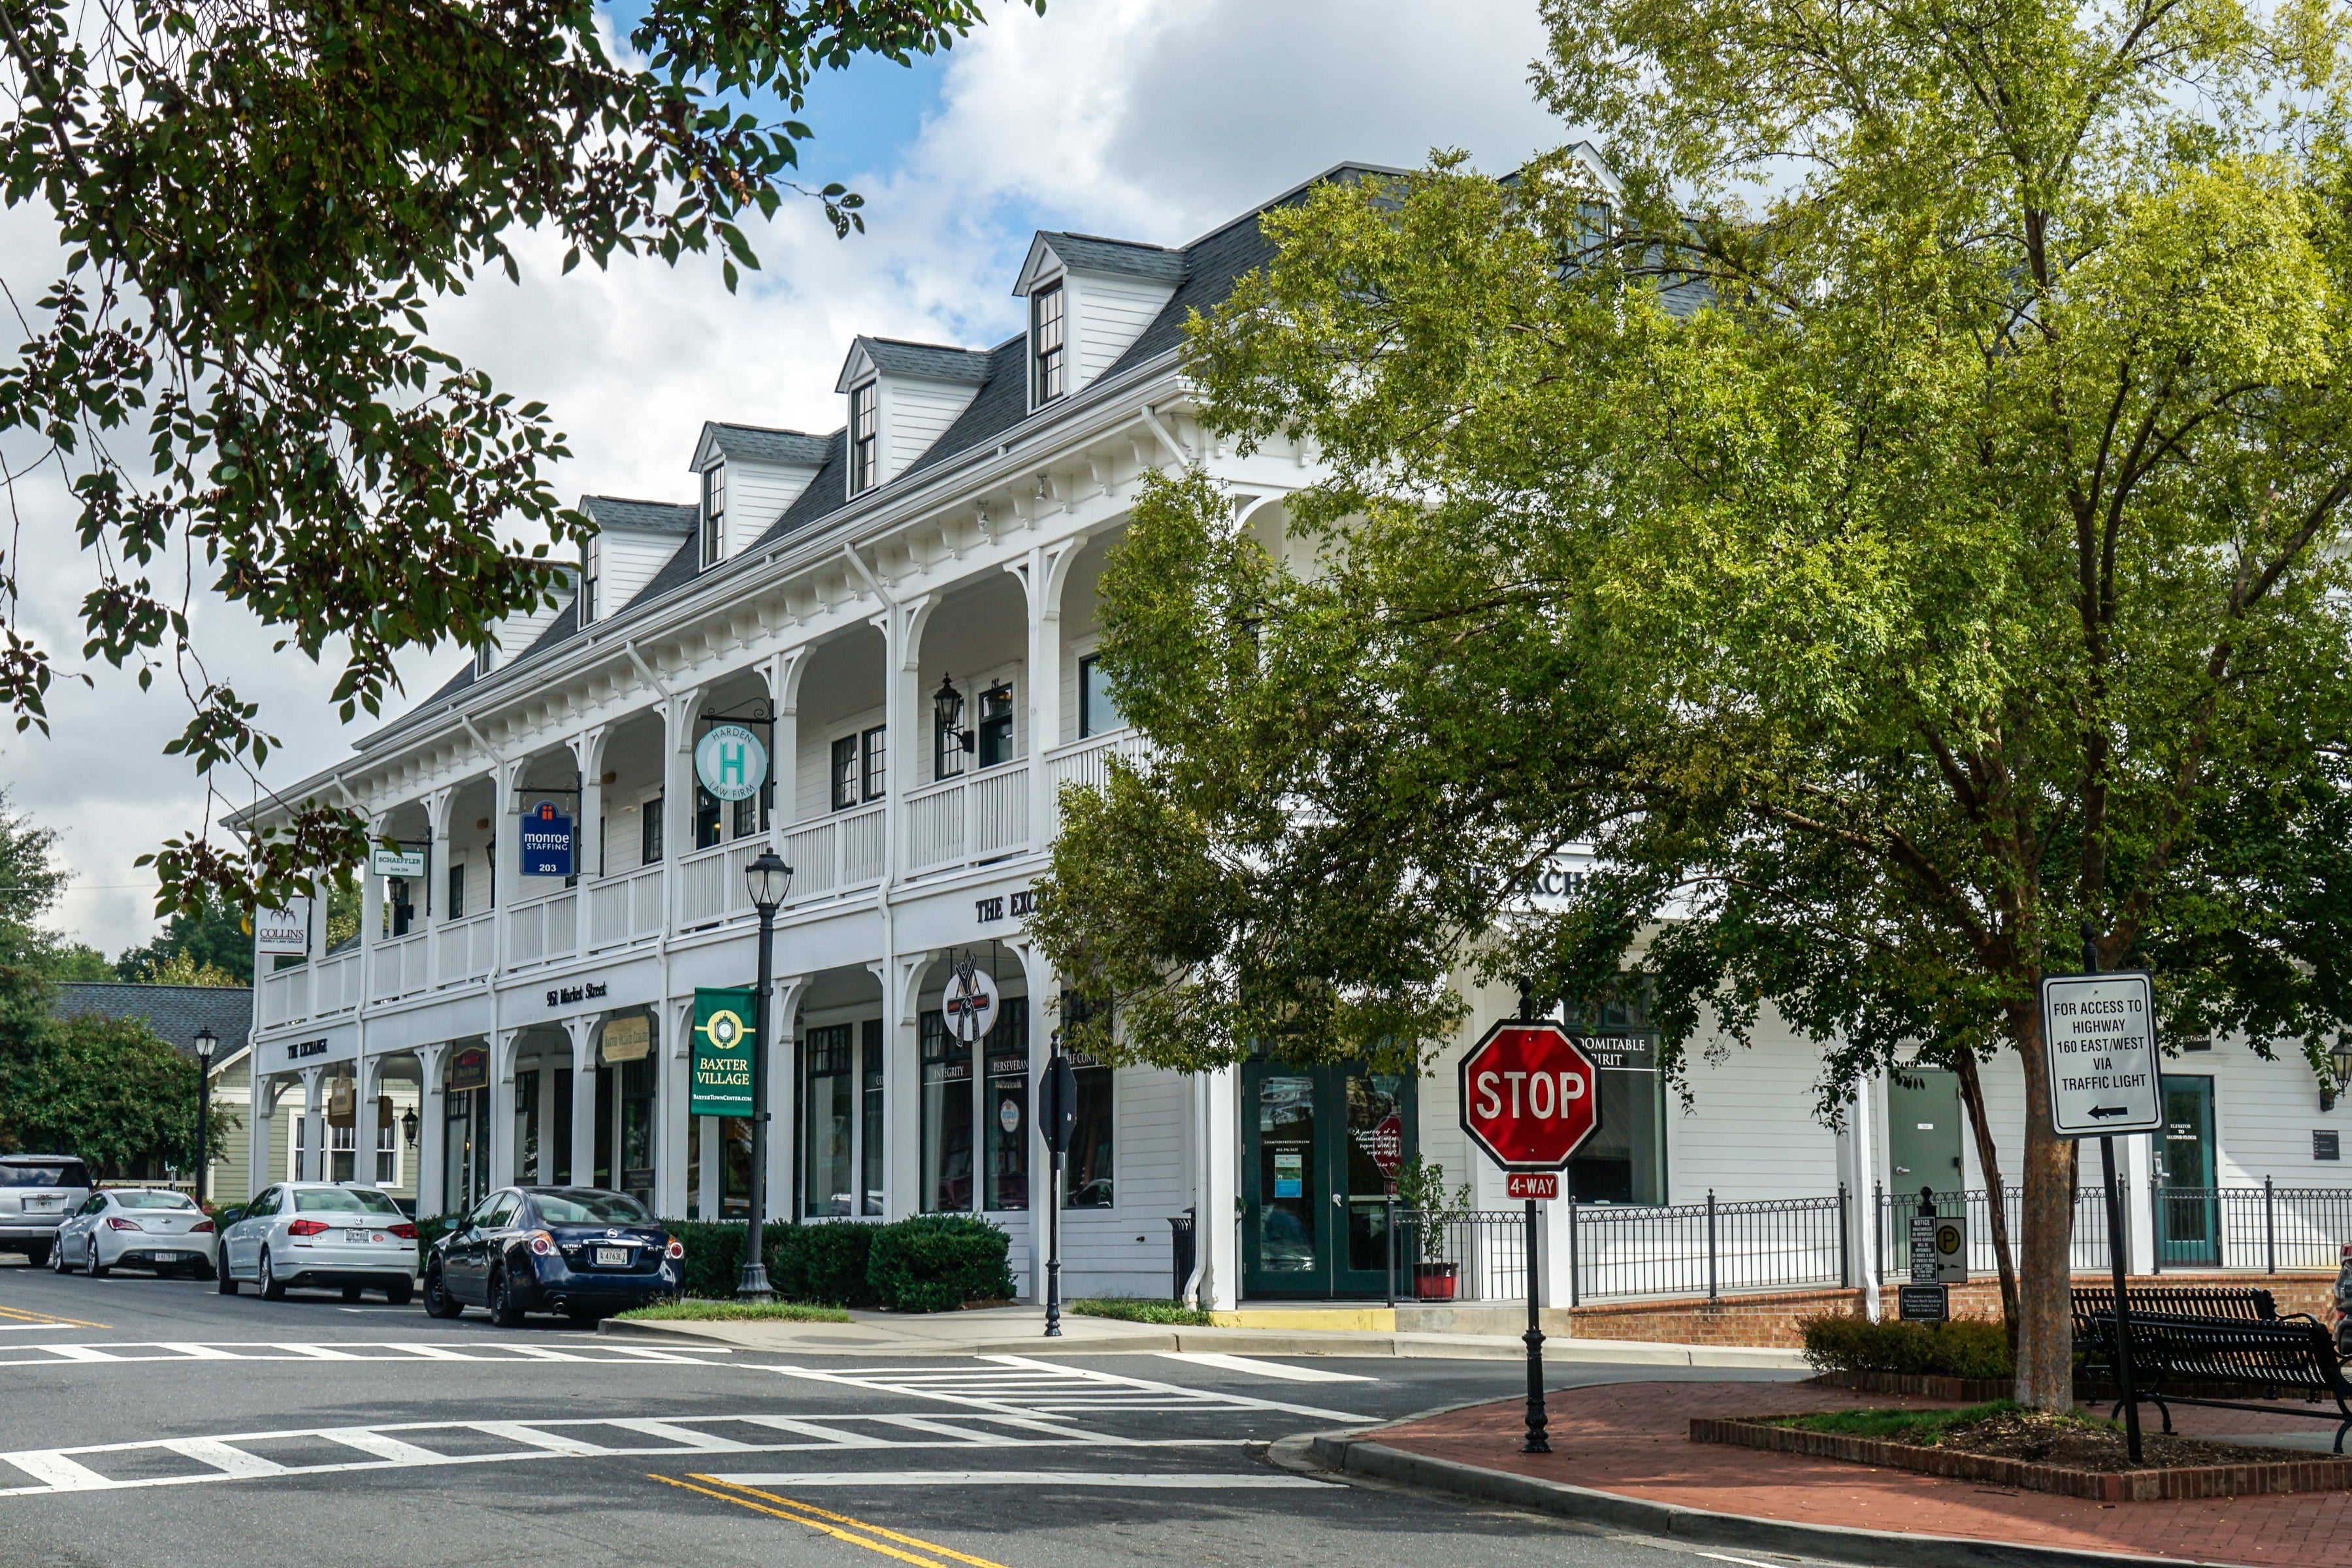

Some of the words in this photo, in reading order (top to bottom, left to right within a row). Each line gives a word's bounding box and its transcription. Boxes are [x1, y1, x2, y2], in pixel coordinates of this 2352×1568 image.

[711, 727, 753, 743] HARDEN
[719, 741, 744, 787] H
[708, 781, 728, 797] LAW
[732, 784, 755, 798] FIRM
[525, 833, 569, 843] monroe
[539, 864, 557, 872] 203
[975, 896, 1004, 923] THE
[260, 928, 304, 939] COLLINS
[560, 985, 583, 1004] Market
[585, 981, 607, 1000] Street
[2054, 1003, 2076, 1016] FOR
[2081, 1000, 2124, 1015] ACCESS
[2127, 1000, 2142, 1012] TO
[2072, 1019, 2125, 1034] HIGHWAY
[2057, 1040, 2077, 1053] 160
[2081, 1036, 2144, 1053] EAST/WEST
[700, 1058, 748, 1071] BAXTER
[2093, 1057, 2112, 1070] VIA
[696, 1072, 749, 1085] VILLAGE
[934, 1066, 964, 1079] INTEGRITY
[2062, 1076, 2110, 1091] TRAFFIC
[2113, 1074, 2146, 1088] LIGHT
[1477, 1071, 1585, 1120] STOP
[1511, 1178, 1554, 1194] 4-WAY
